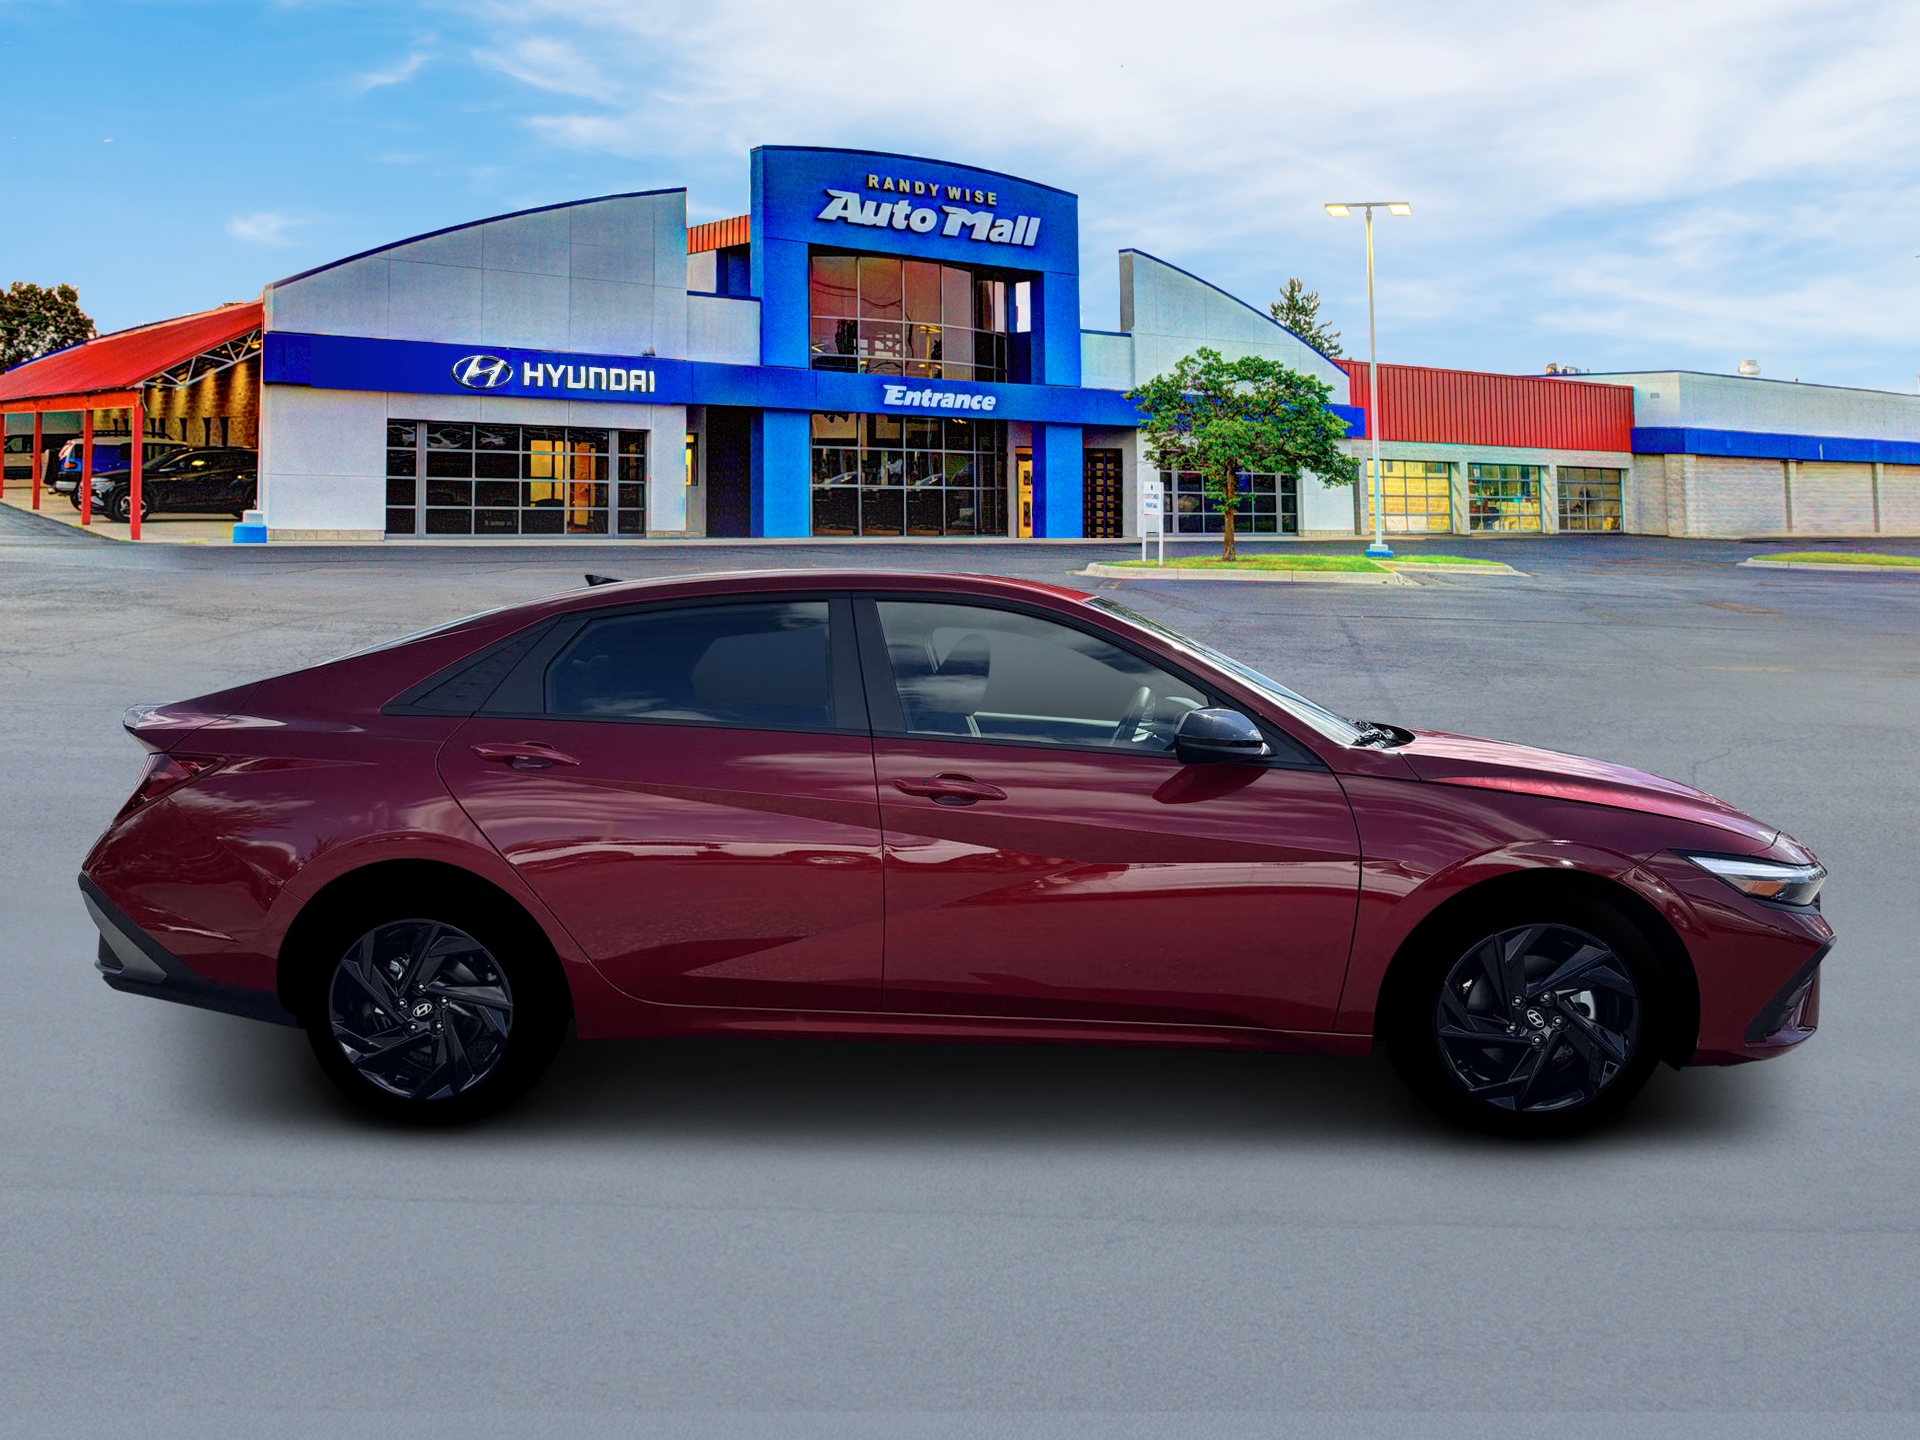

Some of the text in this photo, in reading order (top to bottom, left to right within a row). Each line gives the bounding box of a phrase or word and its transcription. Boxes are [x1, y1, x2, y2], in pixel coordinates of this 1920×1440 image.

[867, 174, 997, 205] RANDY WISE
[816, 189, 1041, 247] Auto Mall
[522, 362, 655, 393] HYUNDAI
[883, 385, 997, 411] Entrance
